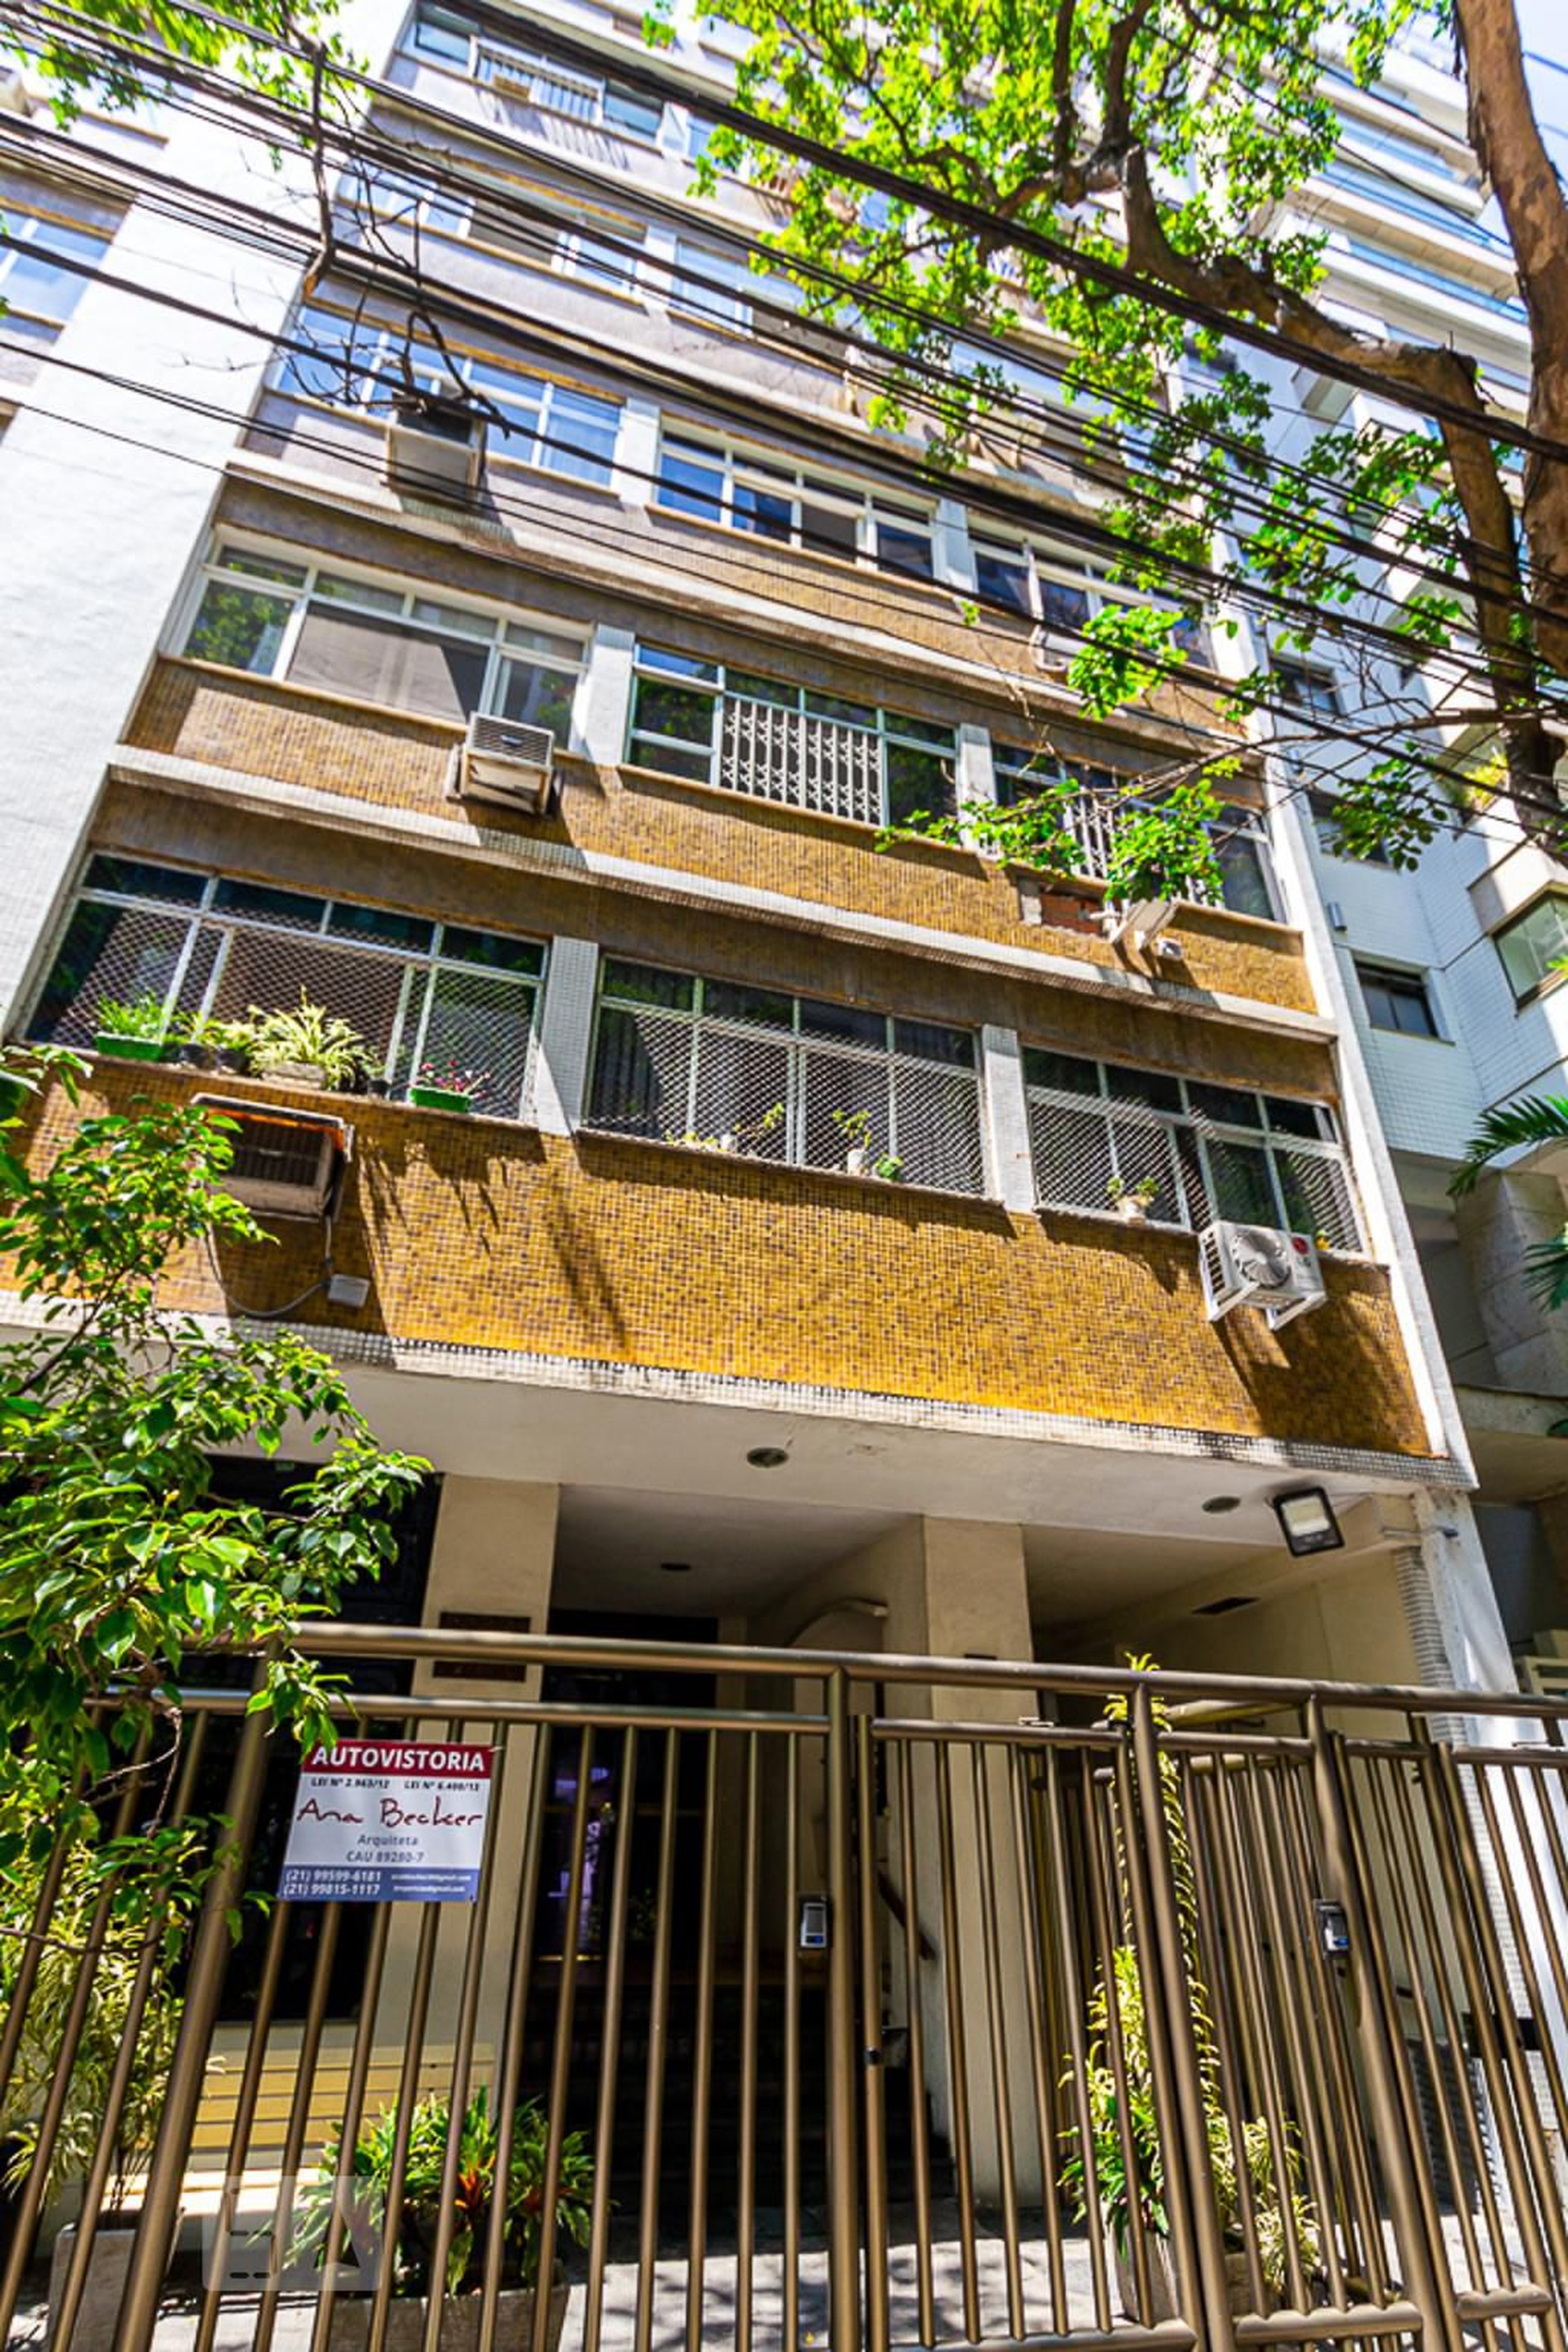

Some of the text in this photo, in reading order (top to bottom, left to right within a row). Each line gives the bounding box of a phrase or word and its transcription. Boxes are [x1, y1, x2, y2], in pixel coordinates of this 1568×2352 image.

[312, 1746, 484, 1771] AUTOVISTORIA
[297, 1796, 483, 1828] Ana Becker
[357, 1834, 418, 1847] Arquiteta
[346, 1850, 373, 1862] CAU
[286, 1869, 311, 1882] (21)
[284, 1884, 309, 1897] (21)
